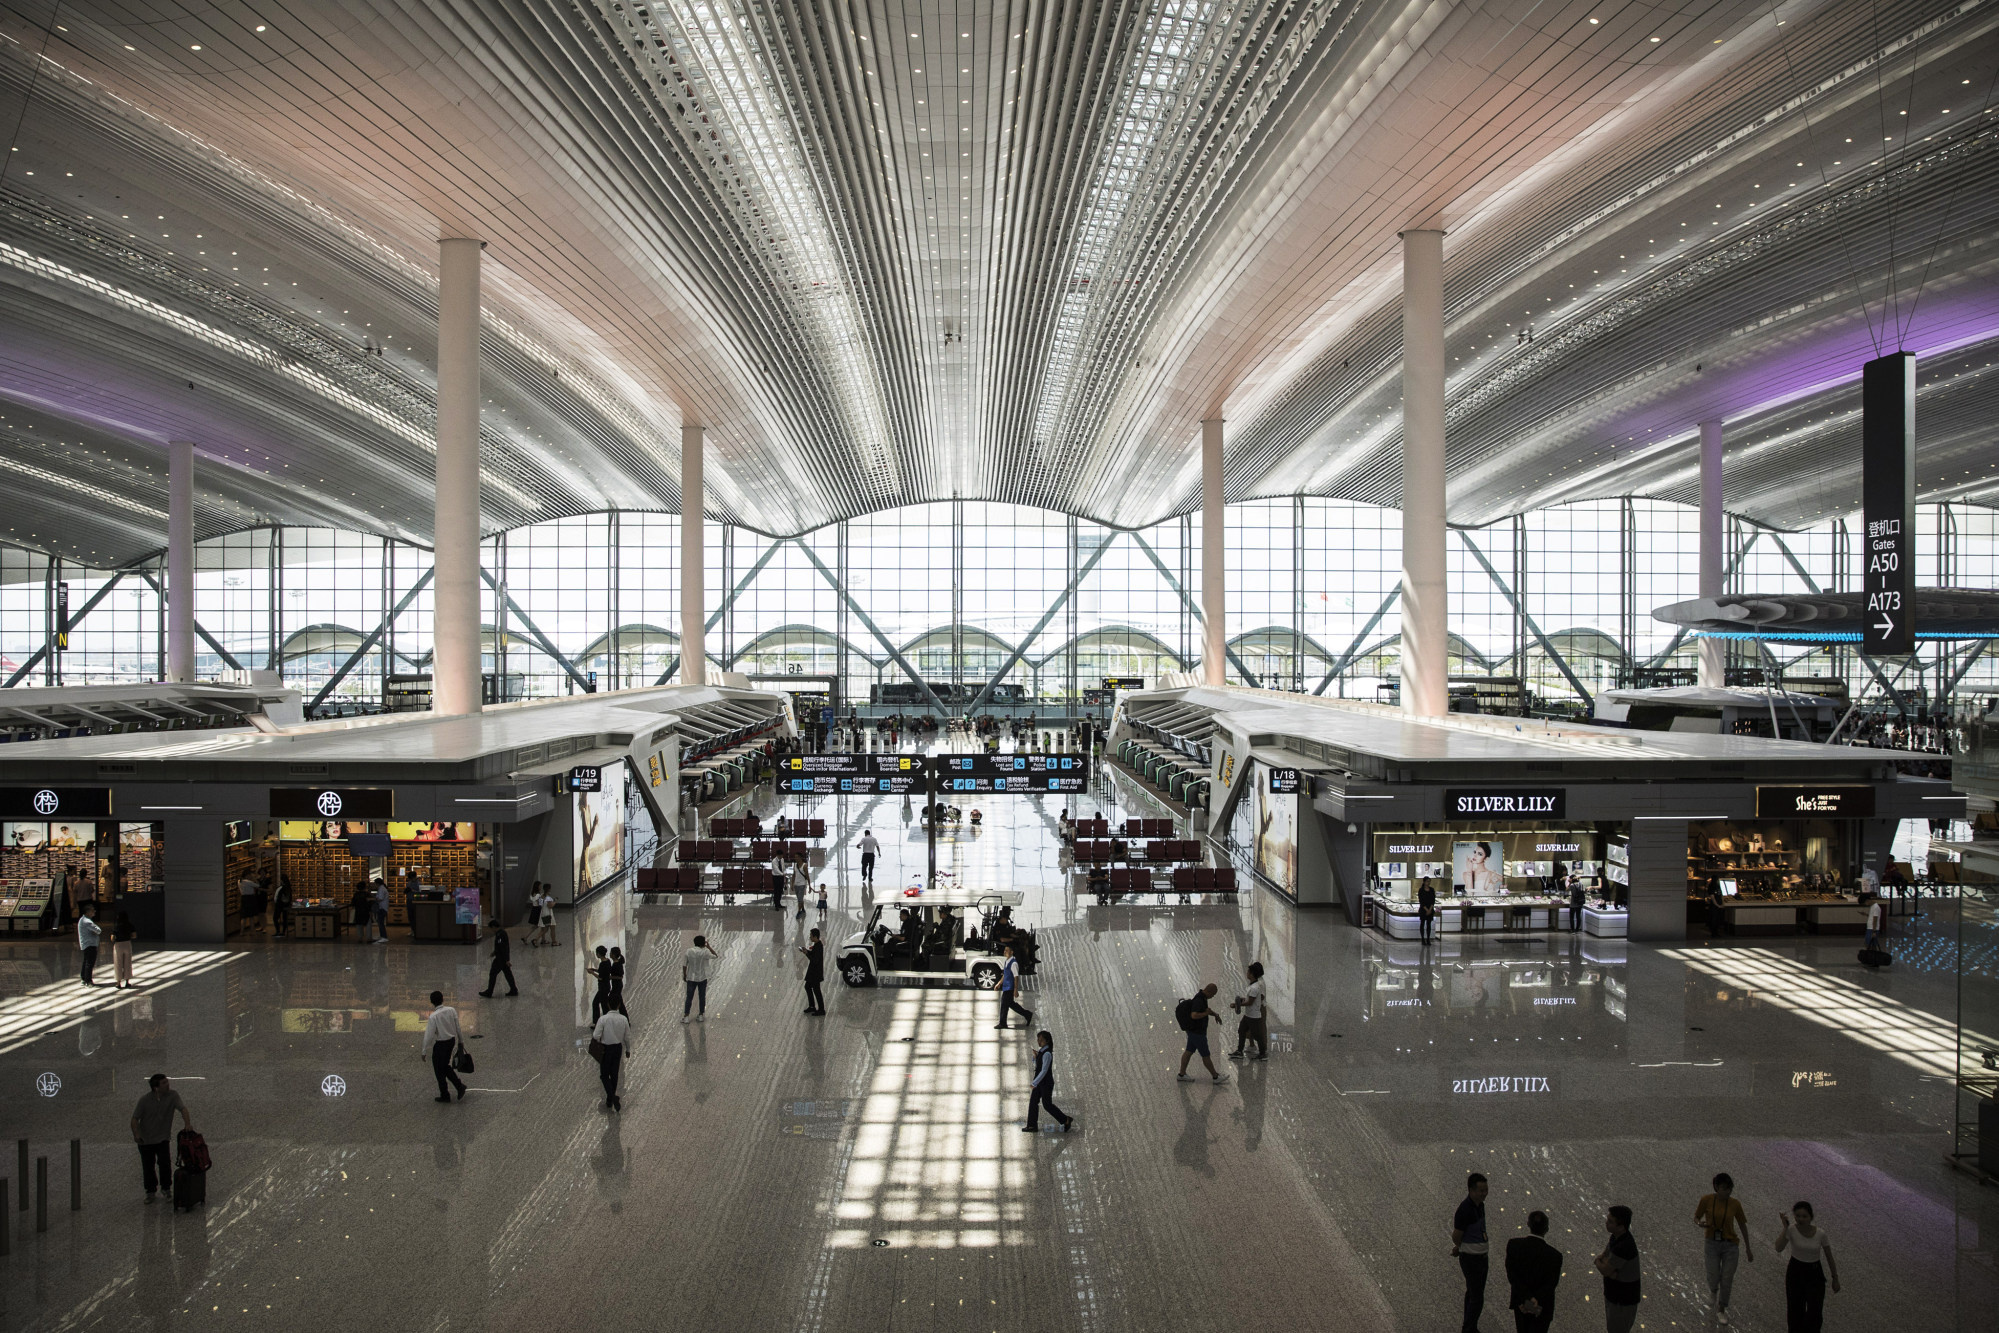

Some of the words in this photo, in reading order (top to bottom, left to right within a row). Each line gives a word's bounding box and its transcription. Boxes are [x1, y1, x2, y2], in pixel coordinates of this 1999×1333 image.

[1869, 519, 1900, 538] 登机口
[1872, 540, 1895, 550] Gates
[1869, 552, 1898, 573] A50
[1868, 591, 1901, 611] A173
[59, 632, 67, 647] N
[575, 769, 596, 777] L/19
[1274, 771, 1295, 779] L/18
[1457, 796, 1515, 812] SILVER
[1517, 796, 1556, 812] LILY
[1795, 795, 1817, 811] She's
[1389, 845, 1415, 853] SILVER
[1416, 845, 1434, 853] LILY
[1536, 844, 1561, 852] SILVER
[1562, 844, 1580, 852] LILY
